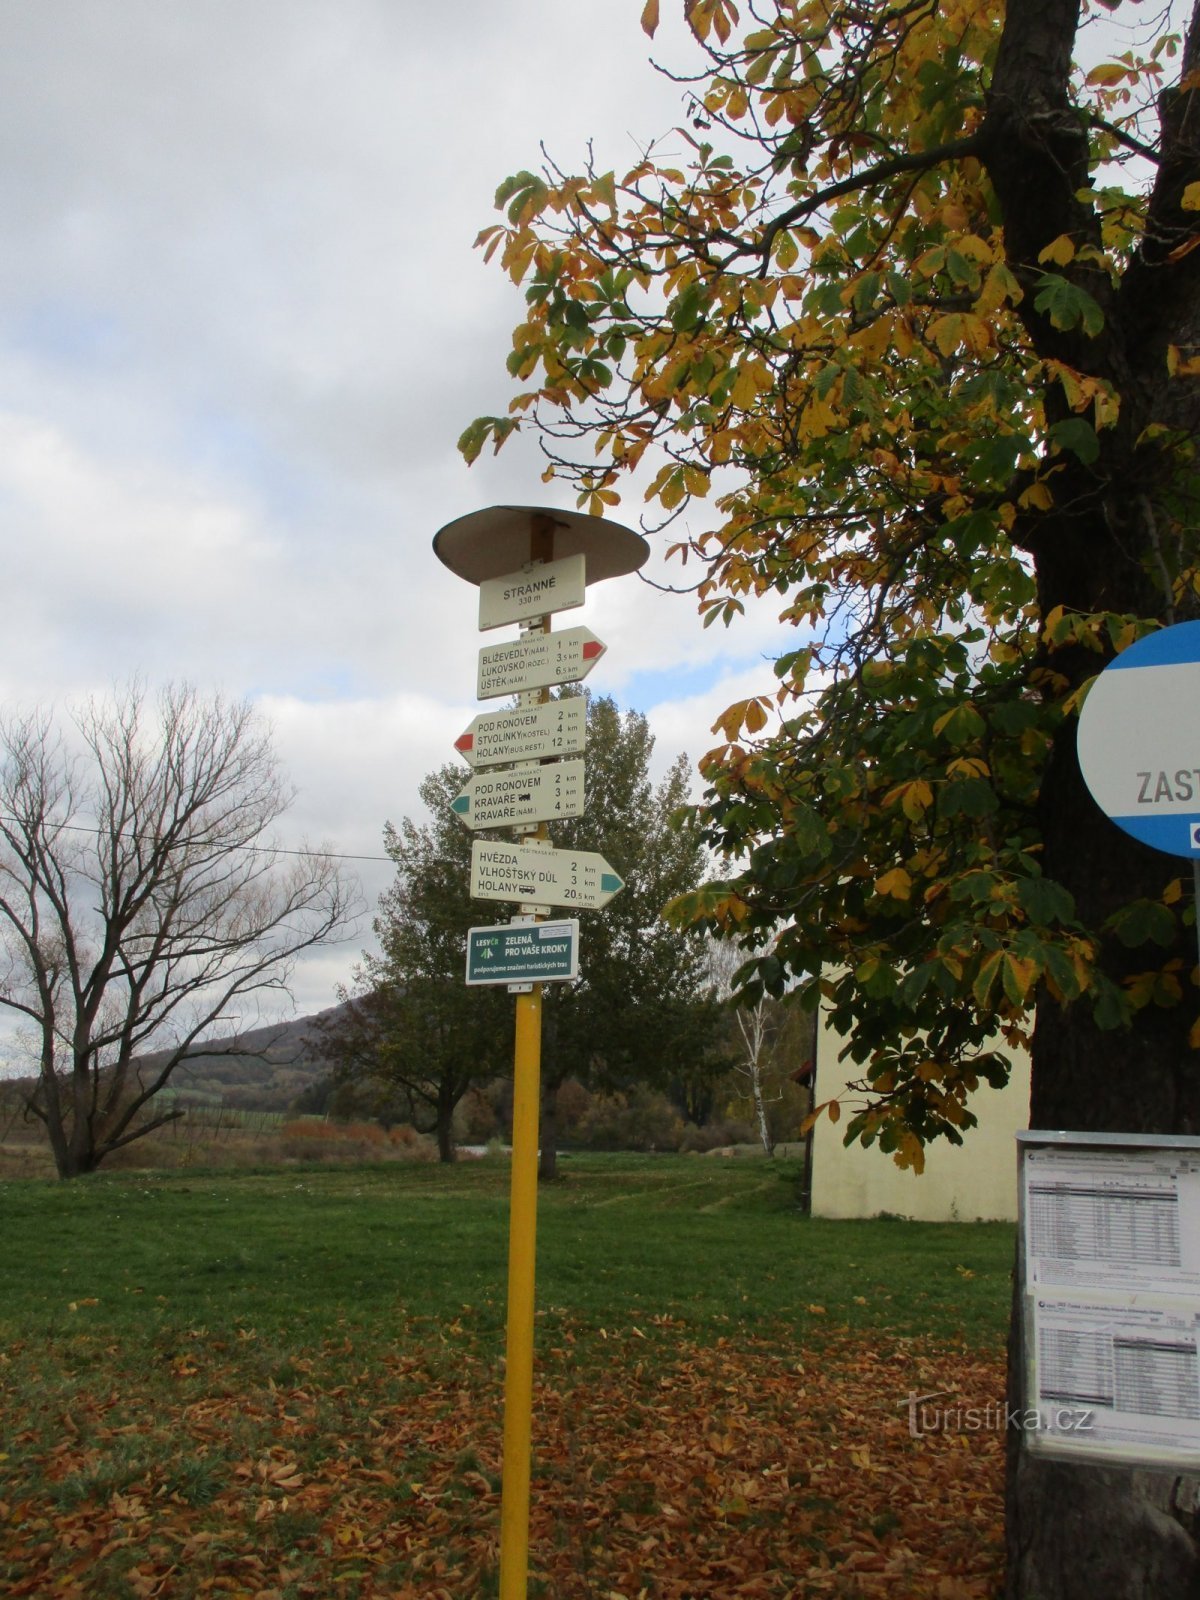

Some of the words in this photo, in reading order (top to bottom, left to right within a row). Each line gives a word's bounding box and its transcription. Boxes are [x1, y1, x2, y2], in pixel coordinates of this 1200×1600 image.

[503, 576, 556, 600] STRANNÉ
[518, 596, 532, 606] 330
[557, 641, 561, 649] 1
[478, 723, 495, 733] POD
[497, 715, 537, 729] RONOVEM
[558, 711, 564, 720] 2
[557, 724, 563, 732] 4
[552, 737, 563, 747] 12
[475, 785, 493, 795] POD
[496, 777, 541, 792] RONOVEM
[555, 774, 561, 784] 2
[555, 788, 561, 797] 3
[555, 802, 561, 810] 4
[480, 851, 518, 865] HVĚZDA
[571, 862, 577, 871] 2
[539, 871, 558, 883] DŮL
[571, 876, 577, 885] 3
[478, 880, 518, 893] HOLANY
[505, 934, 532, 946] ZELENÁ
[505, 948, 520, 957] PRO
[521, 945, 540, 956] VAŠE
[541, 944, 568, 954] KROKY
[474, 966, 506, 974] podporujeme
